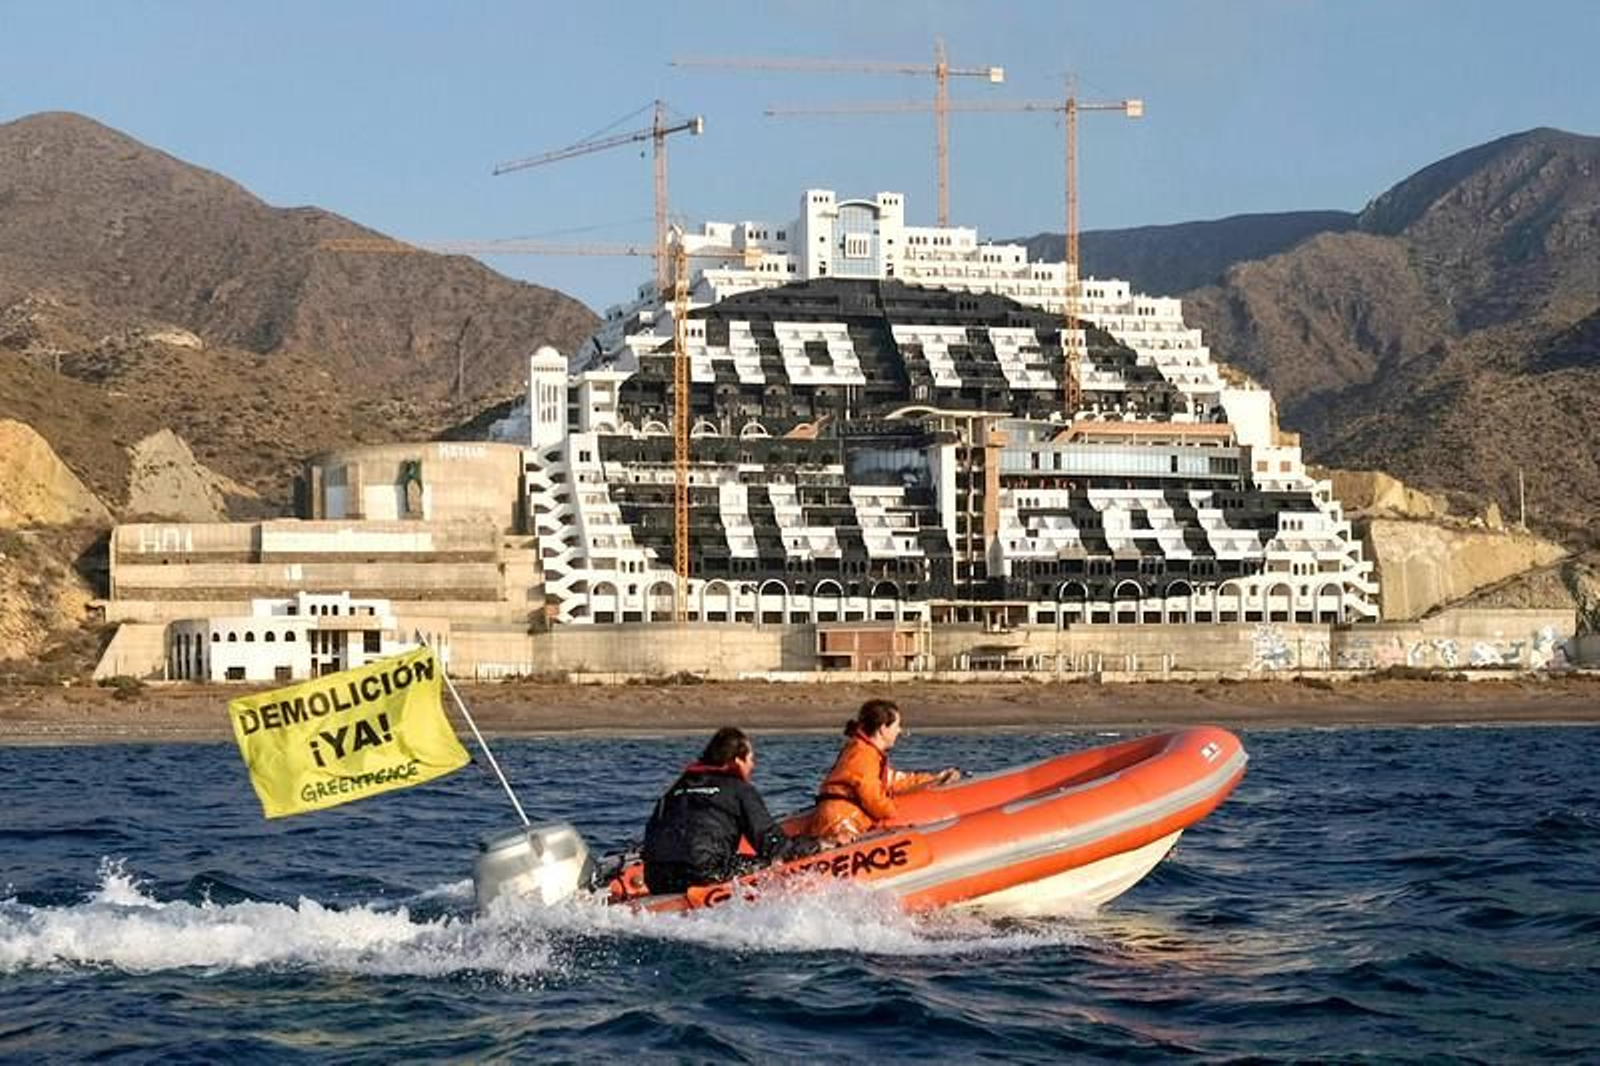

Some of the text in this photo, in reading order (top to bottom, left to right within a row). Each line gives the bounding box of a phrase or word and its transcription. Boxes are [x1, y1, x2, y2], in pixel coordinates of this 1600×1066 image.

[680, 319, 1126, 389] HOTEL
[719, 482, 1264, 560] ILEGAL
[239, 657, 435, 735] DEMOLICIÓN
[309, 712, 393, 767] ¡YA!
[301, 761, 419, 802] GREENPEACE
